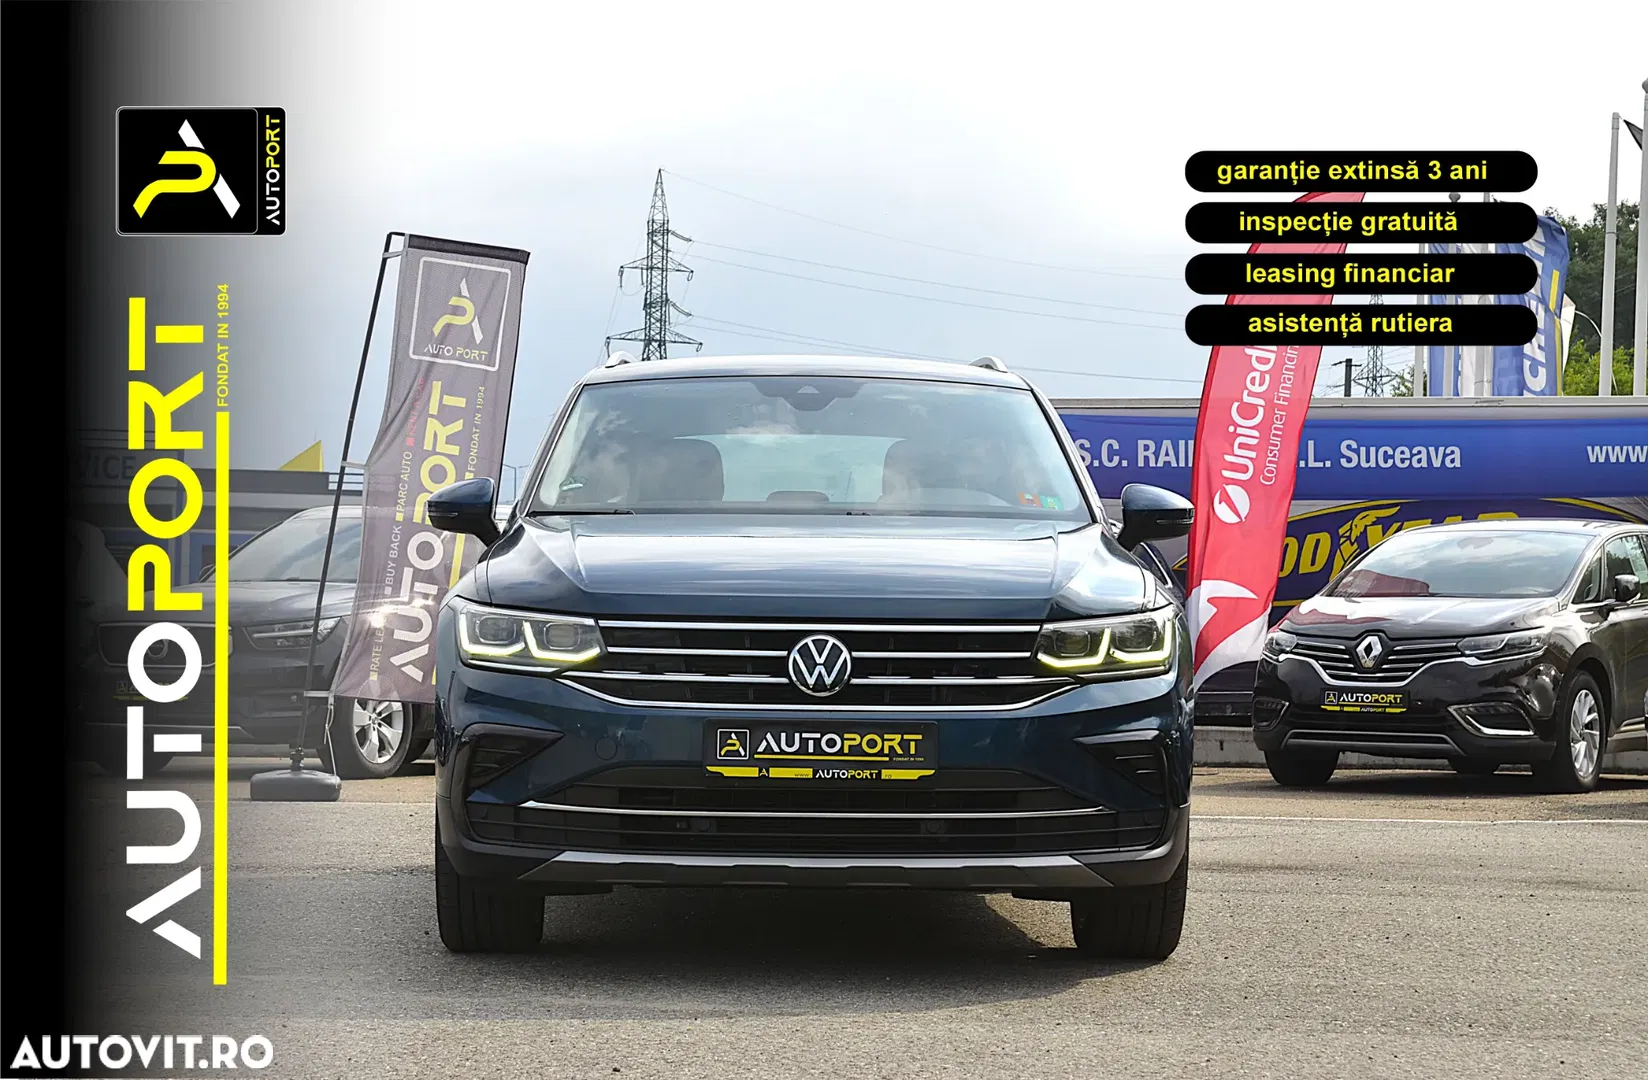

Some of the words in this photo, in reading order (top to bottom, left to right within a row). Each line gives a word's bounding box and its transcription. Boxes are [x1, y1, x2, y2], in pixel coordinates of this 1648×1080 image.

[476, 386, 486, 409] 1994
[474, 413, 482, 424] IN
[1221, 346, 1278, 481] UniCred
[1260, 408, 1287, 485] Consumer
[1274, 346, 1300, 406] Financin
[468, 427, 480, 471] FONDAT
[1340, 439, 1461, 468] Suceava
[401, 452, 413, 481] AUTO
[396, 482, 408, 511] PARC
[389, 525, 402, 558] BACK
[385, 561, 397, 585] BUY
[1340, 693, 1403, 703] AUTOPORT
[756, 732, 923, 754] AUTOPORT
[815, 769, 879, 779] AUTOPORT
